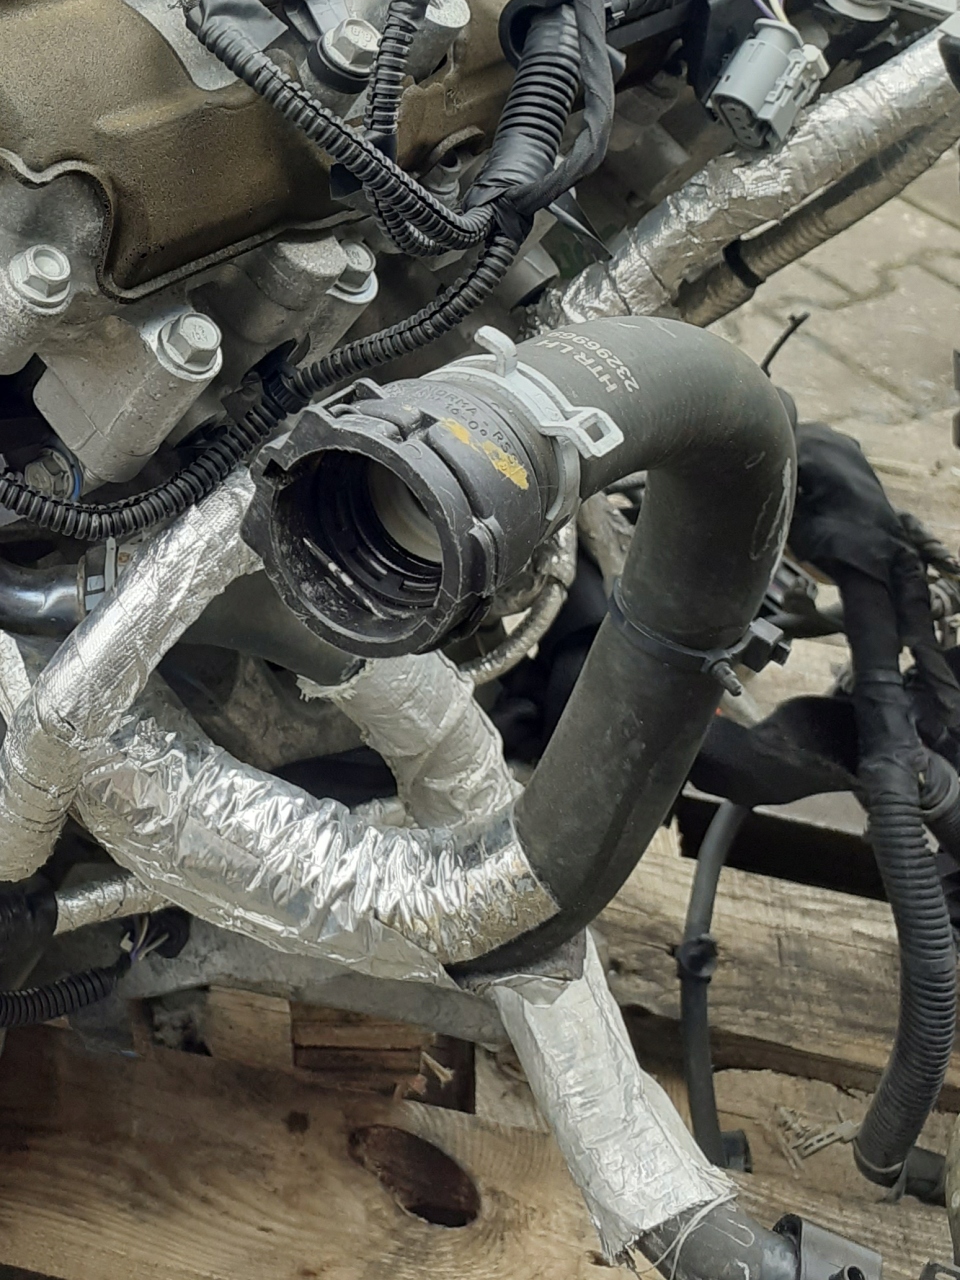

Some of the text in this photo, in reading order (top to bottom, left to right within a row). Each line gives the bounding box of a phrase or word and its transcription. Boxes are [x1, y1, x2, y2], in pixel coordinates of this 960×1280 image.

[534, 339, 618, 393] HTR LH
[547, 331, 640, 393] 23296969
